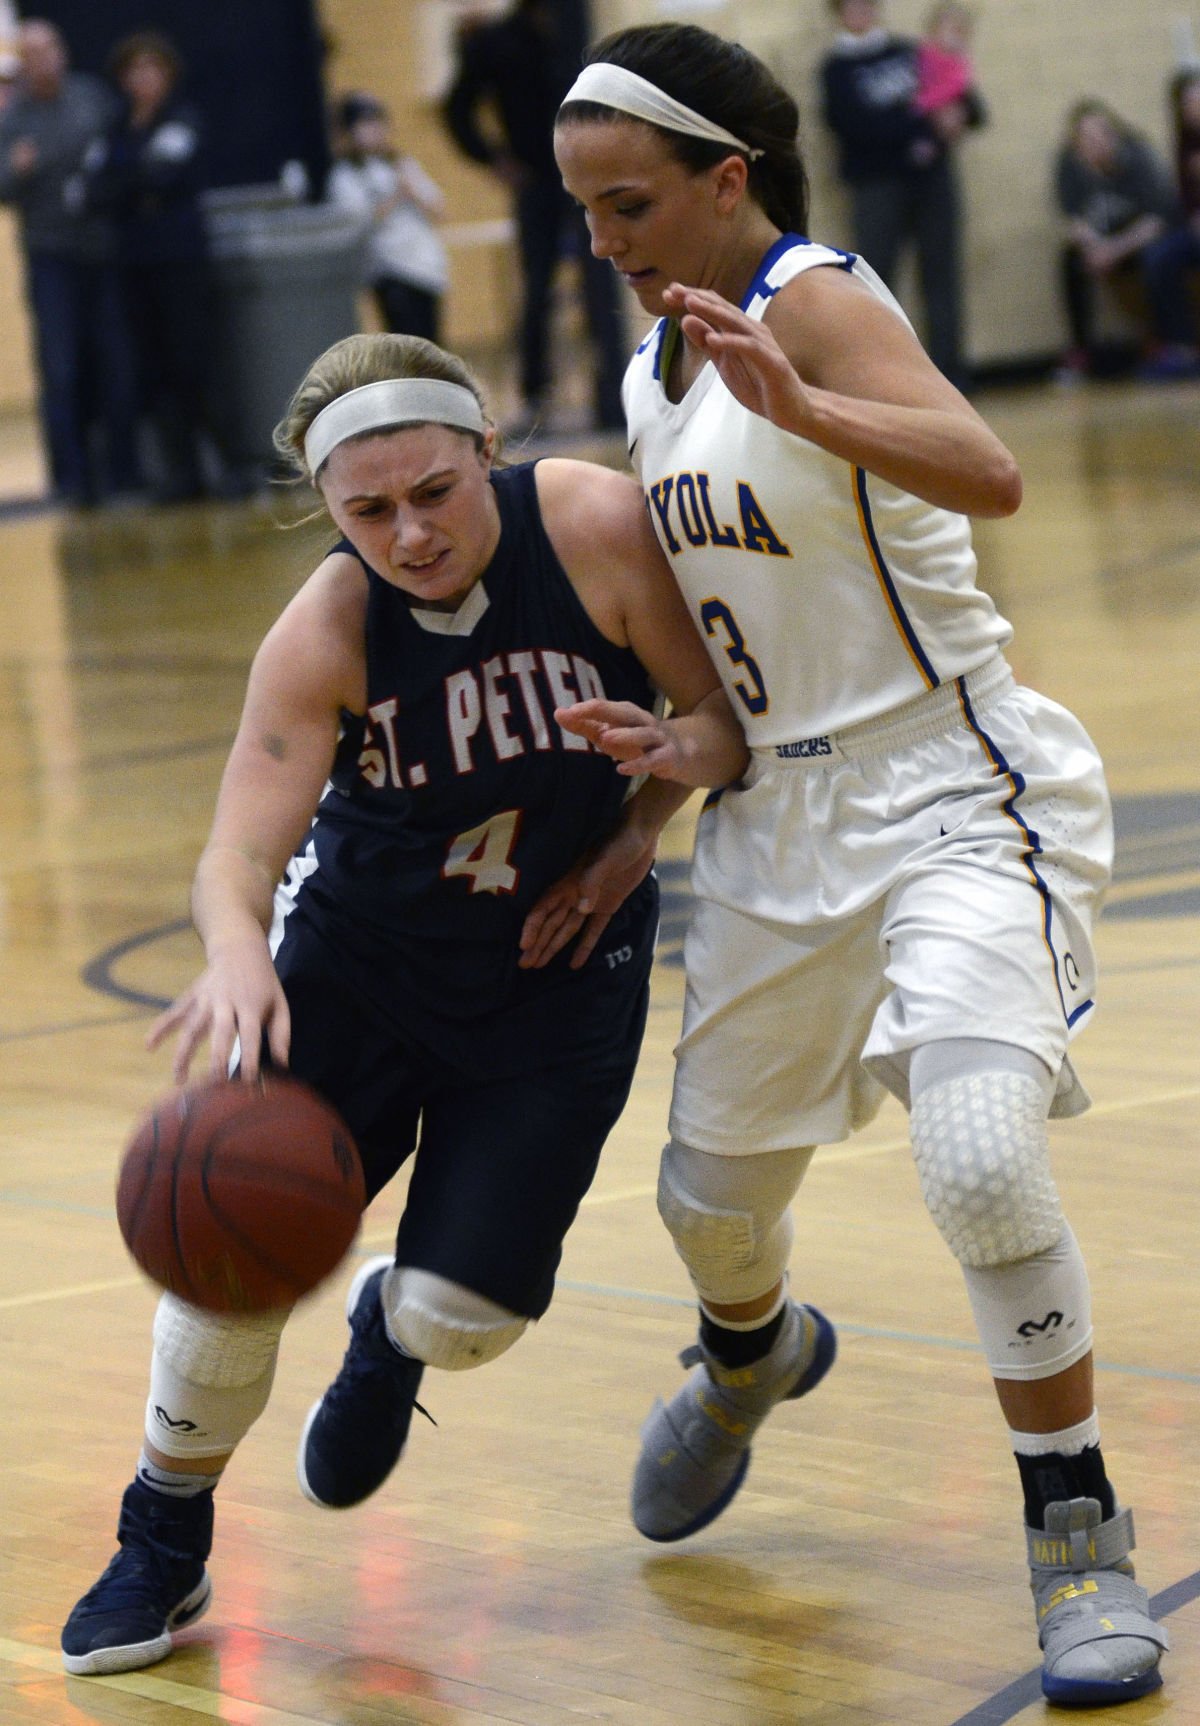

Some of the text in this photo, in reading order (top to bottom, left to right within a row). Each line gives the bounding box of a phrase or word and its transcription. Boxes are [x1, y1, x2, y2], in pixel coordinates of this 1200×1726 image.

[646, 470, 793, 558] YOLA
[700, 596, 768, 717] 3
[440, 807, 523, 896] 4
